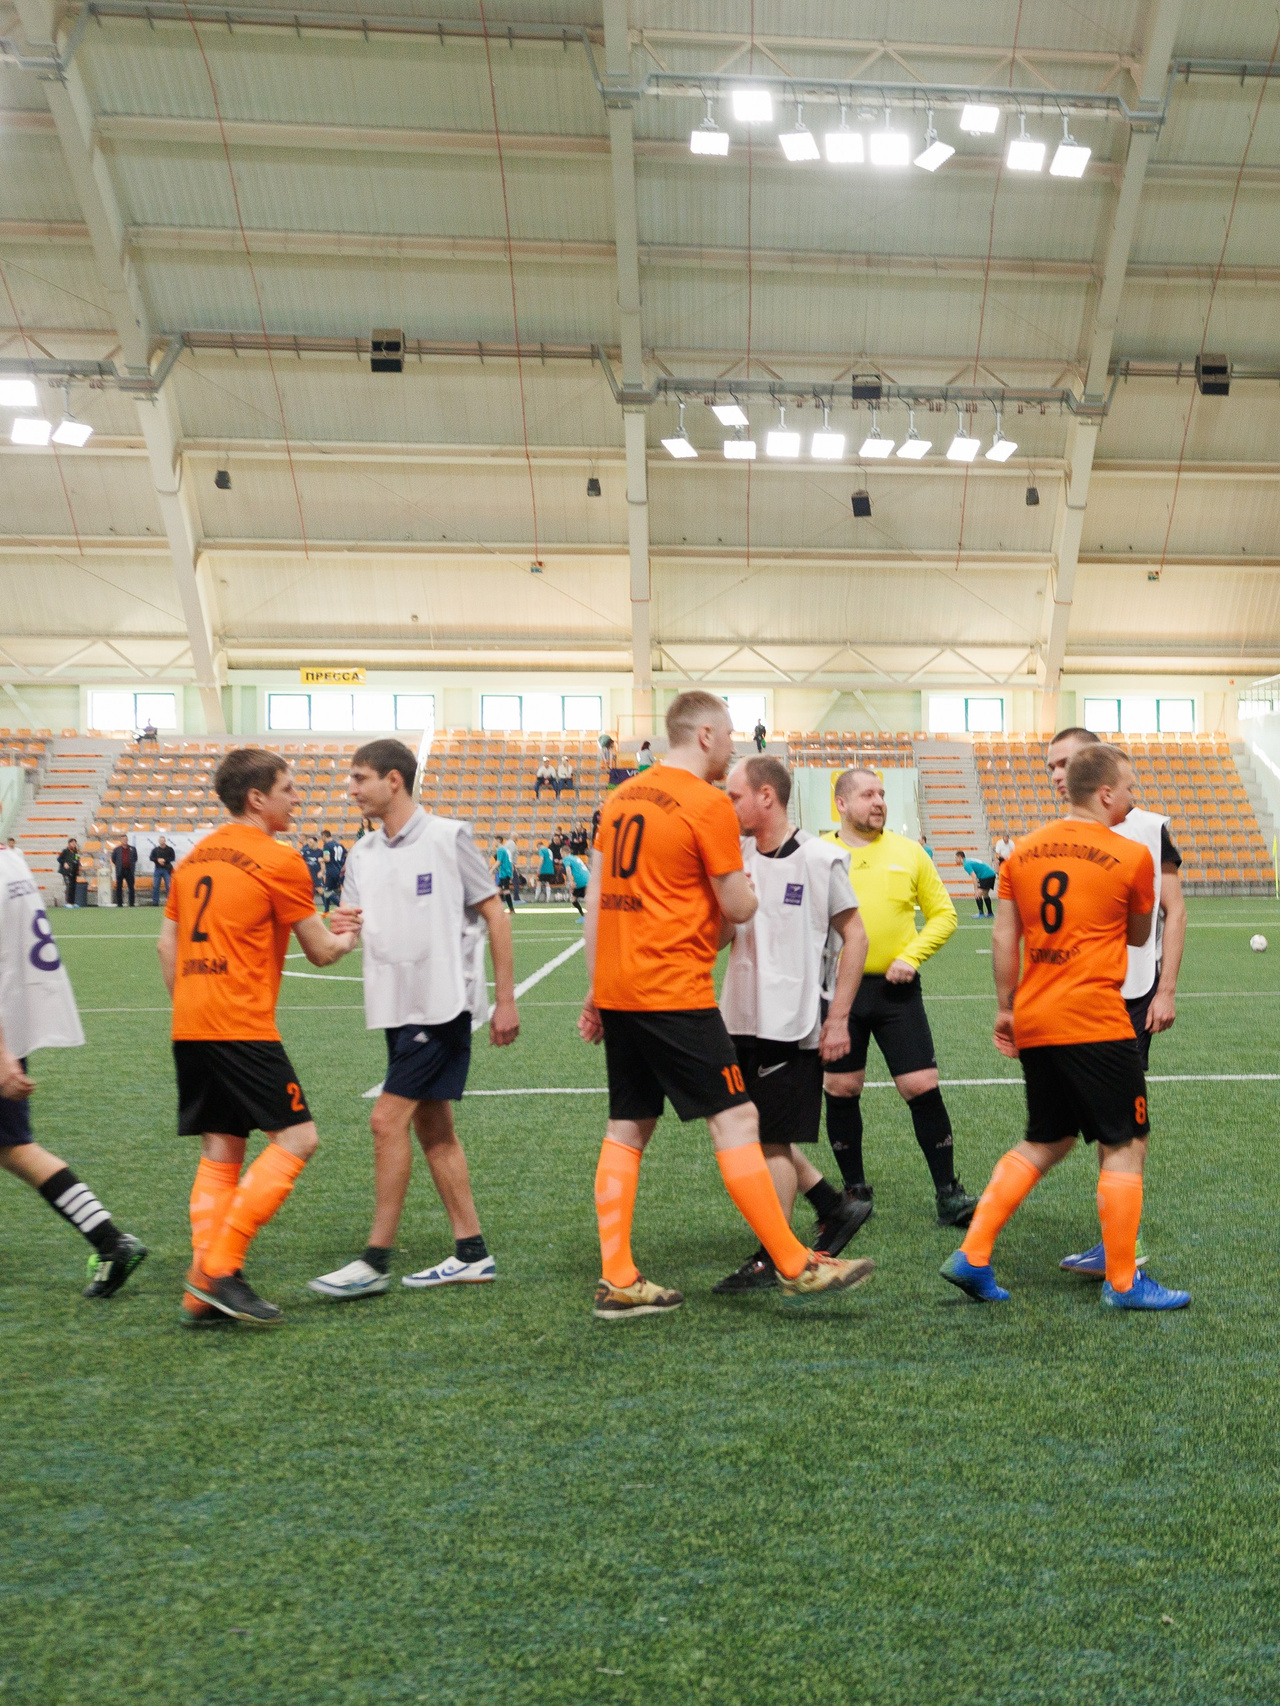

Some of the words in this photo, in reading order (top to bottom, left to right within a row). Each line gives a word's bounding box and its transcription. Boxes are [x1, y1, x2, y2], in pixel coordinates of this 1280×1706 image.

[305, 671, 360, 681] ПРЕССА
[611, 812, 645, 879] 10
[191, 875, 214, 942] 2
[1040, 870, 1069, 934] 8
[29, 909, 61, 971] 8
[286, 1082, 305, 1112] 2
[720, 1063, 746, 1096] 10
[1134, 1095, 1147, 1125] 8
